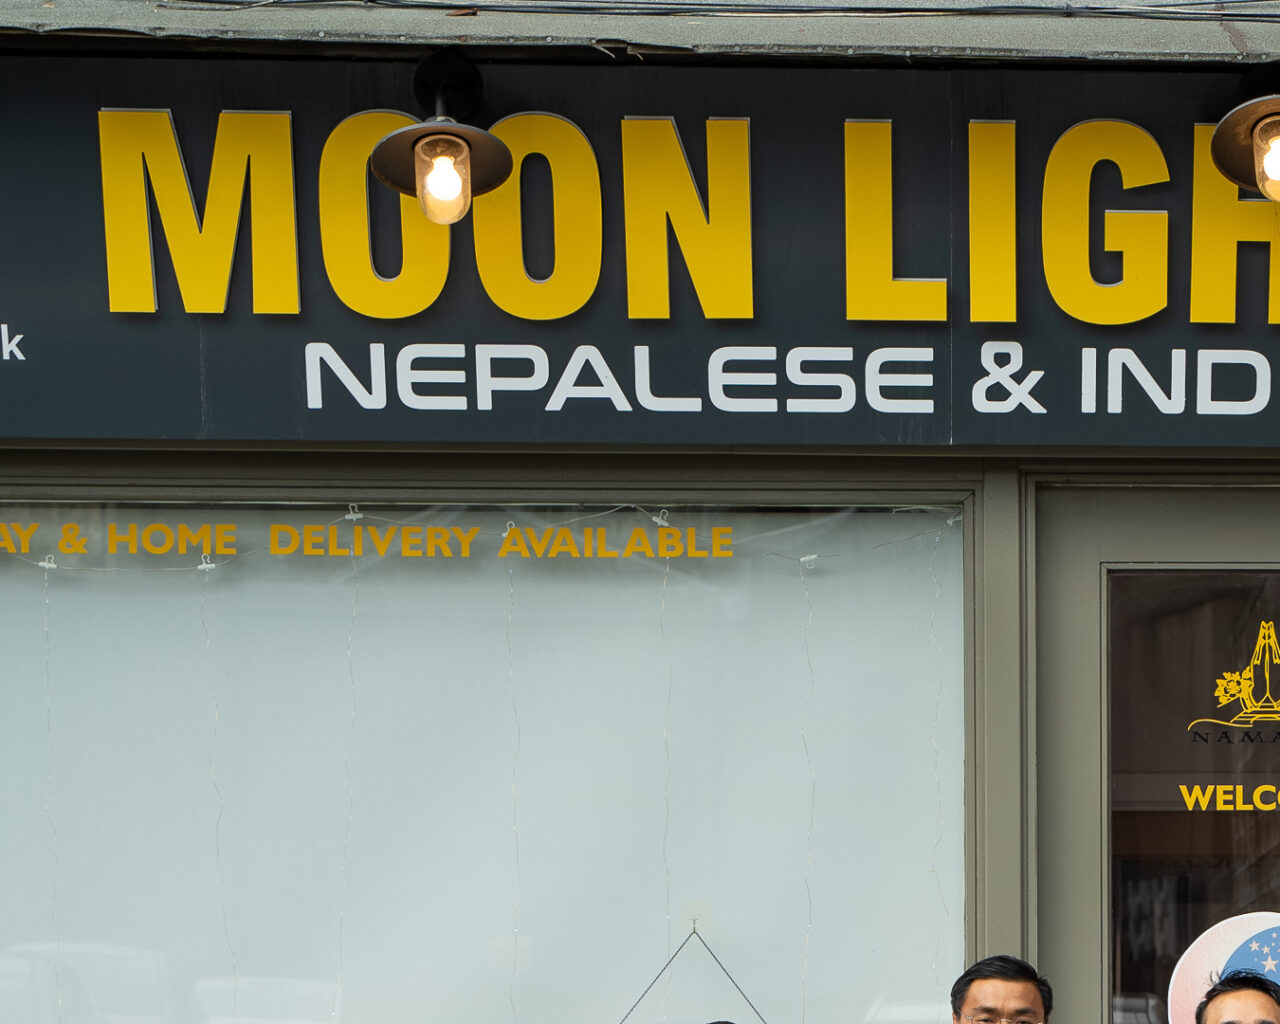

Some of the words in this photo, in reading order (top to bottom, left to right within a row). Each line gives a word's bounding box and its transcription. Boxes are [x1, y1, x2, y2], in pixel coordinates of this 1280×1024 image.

[98, 108, 753, 321] MOON
[0, 323, 26, 360] k
[304, 342, 935, 414] NEPALESE
[971, 341, 1047, 414] &
[0, 523, 40, 554] AY
[58, 523, 88, 554] &
[108, 523, 237, 555] HOME
[269, 525, 481, 557] DELIVERY
[497, 527, 733, 558] AVAILABLE
